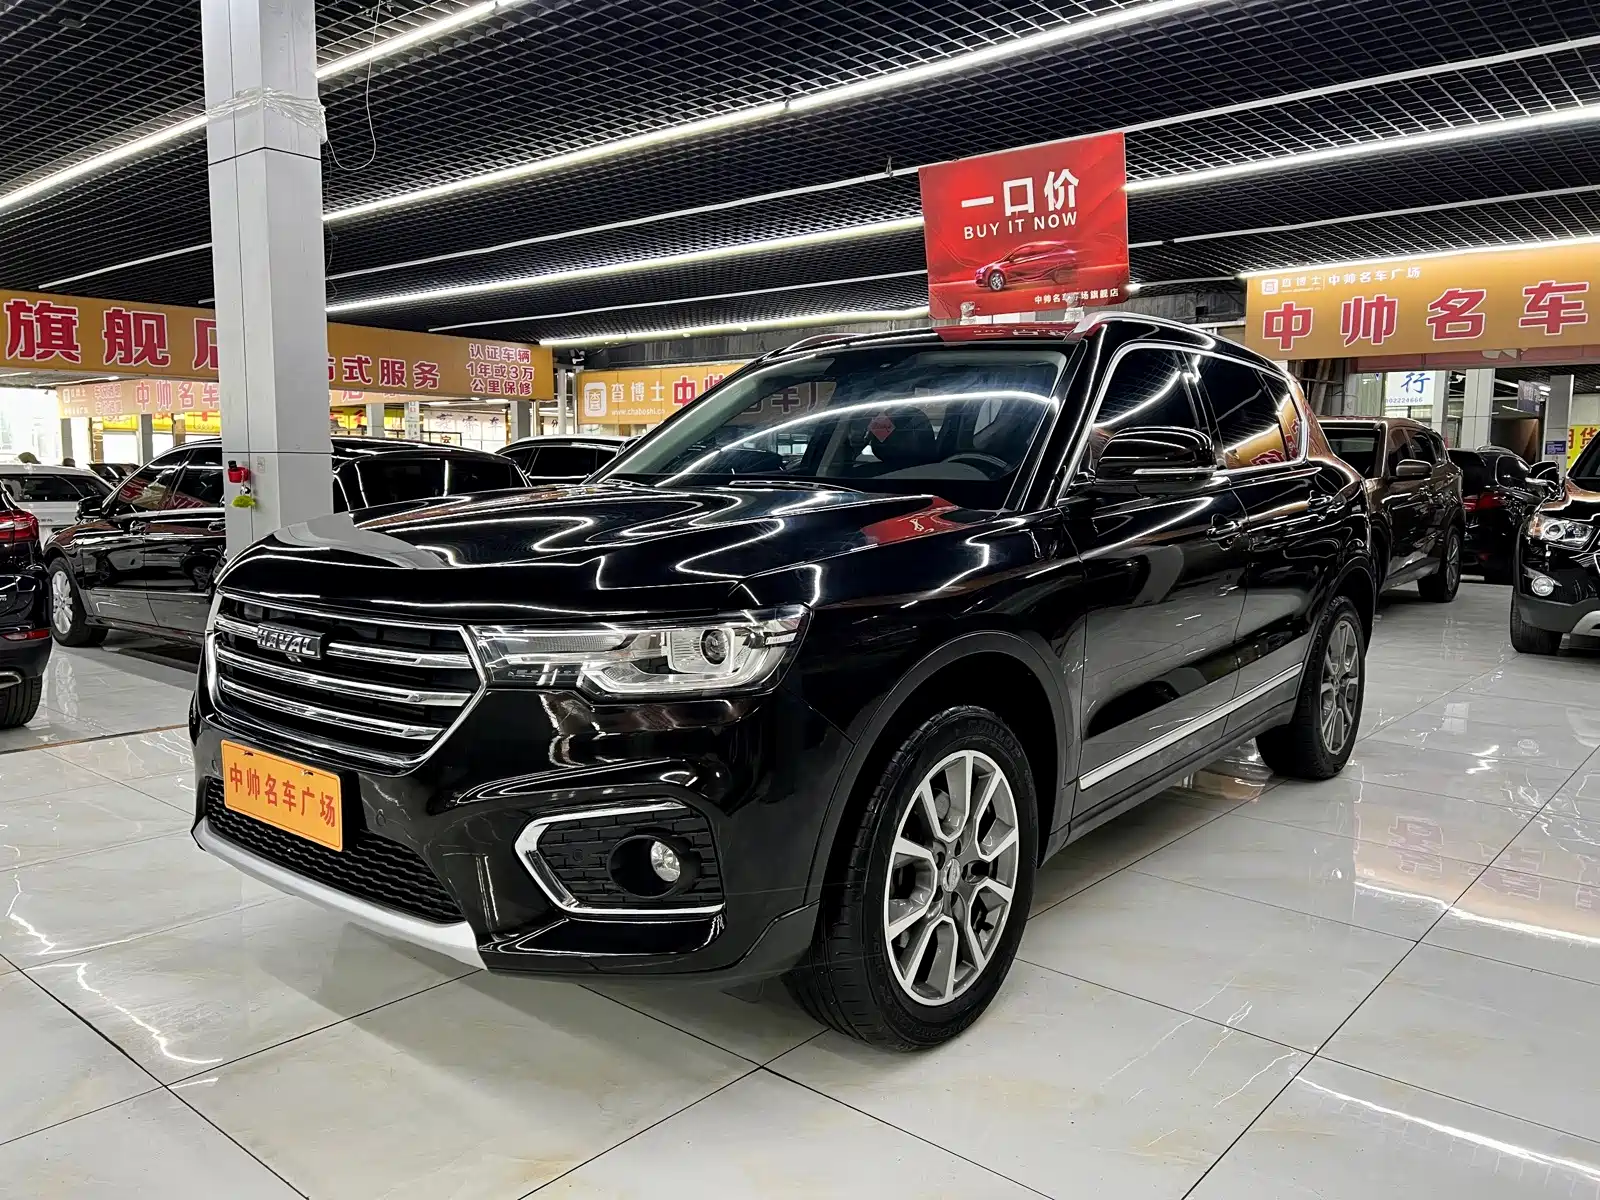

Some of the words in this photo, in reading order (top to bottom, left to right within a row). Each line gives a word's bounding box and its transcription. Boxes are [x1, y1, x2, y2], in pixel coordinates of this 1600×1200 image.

[961, 168, 1080, 217] 一口价
[963, 222, 1001, 240] BUY
[1008, 218, 1026, 234] IT
[1034, 211, 1078, 231] NOW
[1328, 266, 1422, 287] 中帅名车广场
[1263, 280, 1590, 351] 中帅名车
[469, 344, 531, 363] 认证车辆
[465, 362, 534, 381] 1年或3万
[471, 378, 532, 396] 公里保修
[611, 381, 665, 402] 查博士
[1400, 372, 1431, 394] 行
[257, 629, 316, 655] HAVAL
[229, 762, 336, 828] 中帅名车广场
